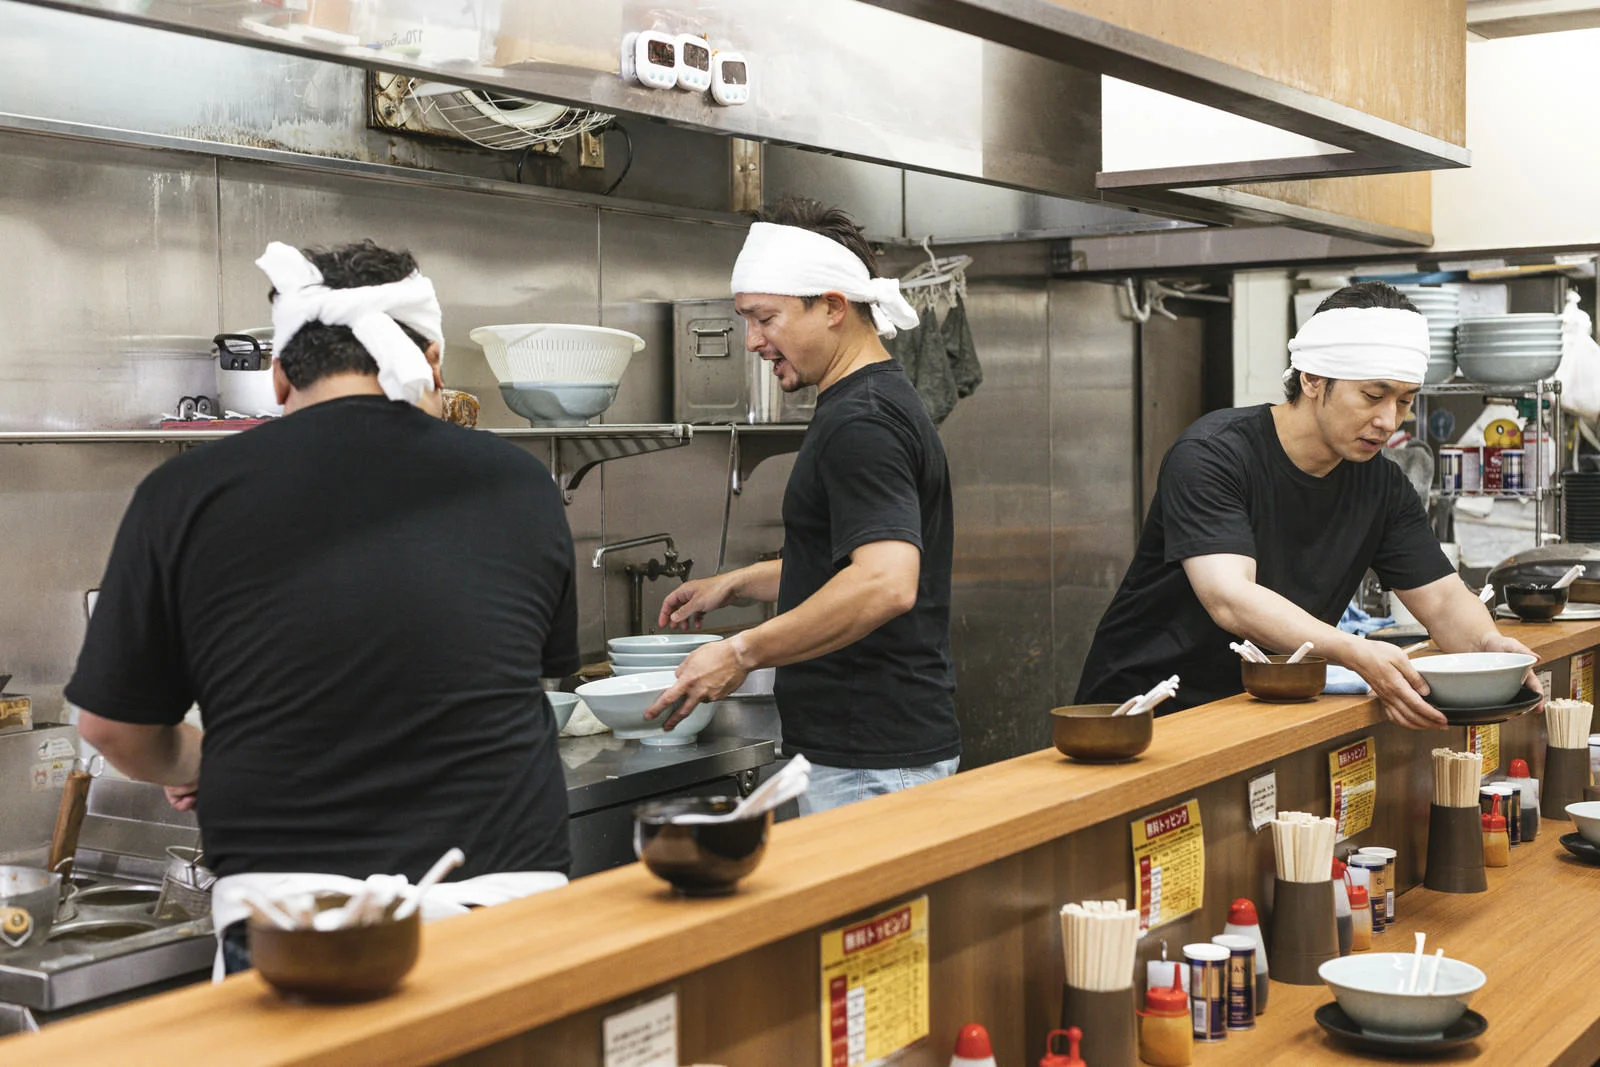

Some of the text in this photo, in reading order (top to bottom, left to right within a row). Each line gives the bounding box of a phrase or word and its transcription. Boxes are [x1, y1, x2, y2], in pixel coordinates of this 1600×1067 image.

[1146, 809, 1188, 837] 無料トッピング
